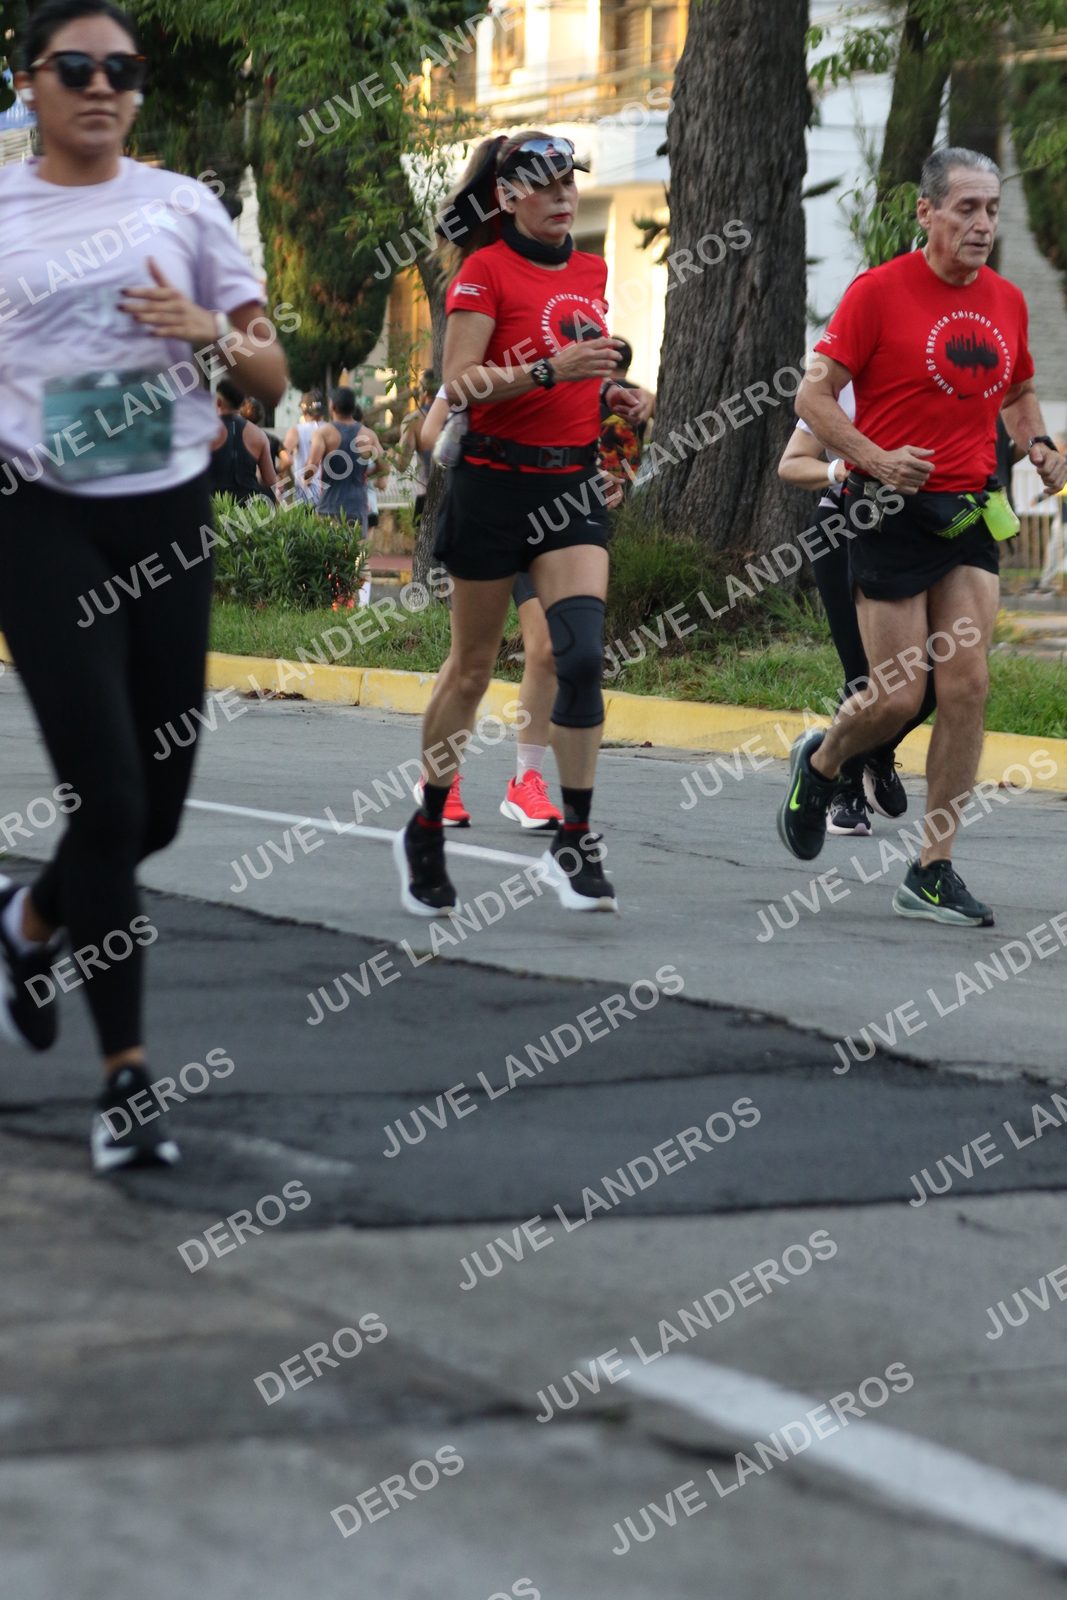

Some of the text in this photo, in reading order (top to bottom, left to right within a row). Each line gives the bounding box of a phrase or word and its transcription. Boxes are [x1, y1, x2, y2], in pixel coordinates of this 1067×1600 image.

[951, 310, 992, 328] CHICAGO
[926, 316, 950, 353] AMERICA
[926, 358, 936, 371] OF
